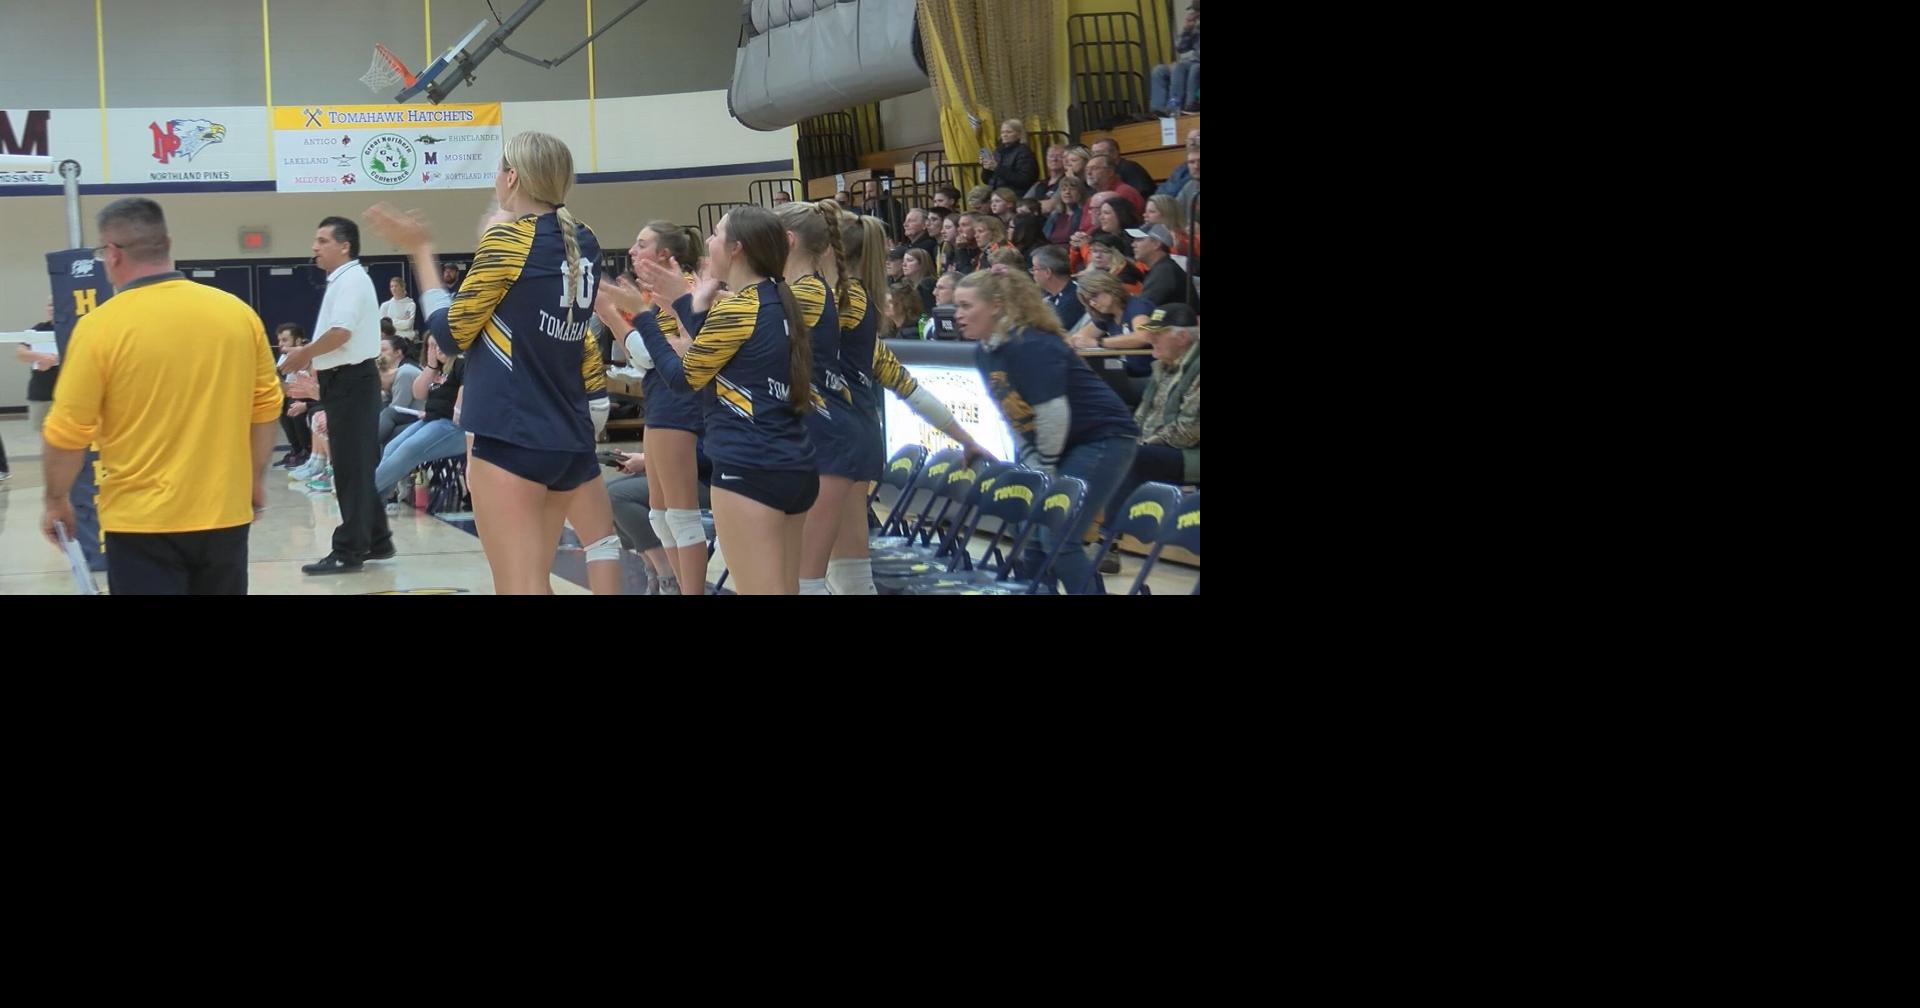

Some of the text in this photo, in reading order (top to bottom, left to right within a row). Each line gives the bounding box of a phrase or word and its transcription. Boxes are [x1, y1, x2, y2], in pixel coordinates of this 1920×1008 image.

[328, 110, 473, 123] TOMAHAWK HATCHETS
[444, 153, 482, 161] MOSINEE
[150, 171, 230, 180] NORTHLAND PINES
[559, 257, 595, 309] 10
